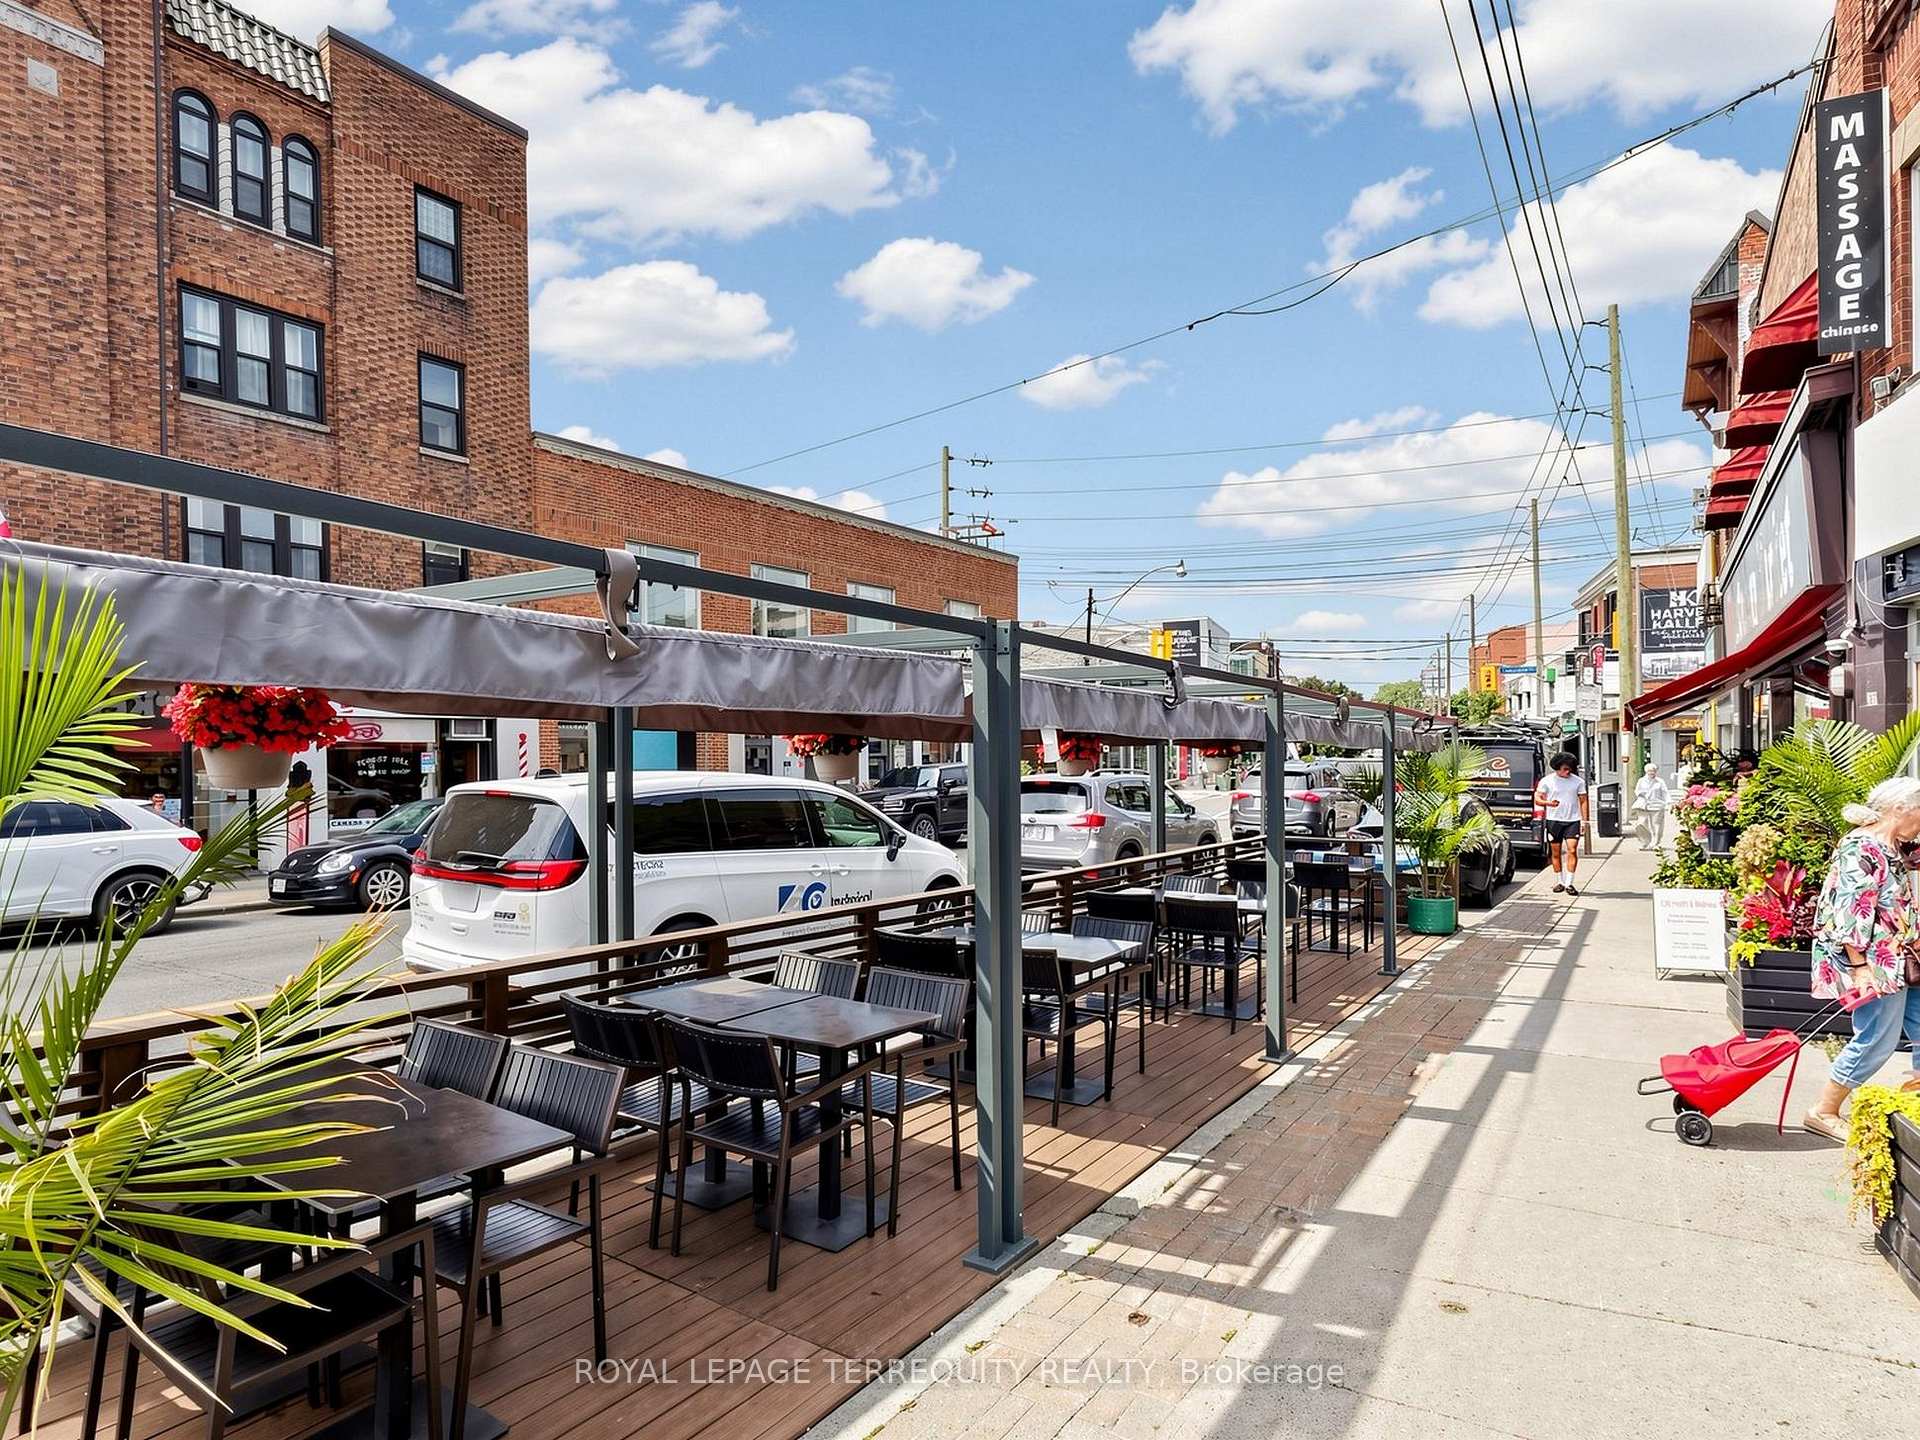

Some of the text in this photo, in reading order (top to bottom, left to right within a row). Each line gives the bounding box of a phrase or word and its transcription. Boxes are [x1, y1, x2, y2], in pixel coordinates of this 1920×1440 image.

[1830, 111, 1865, 320] MASSAGE
[1821, 323, 1879, 338] chinese
[1651, 607, 1705, 620] HARVE
